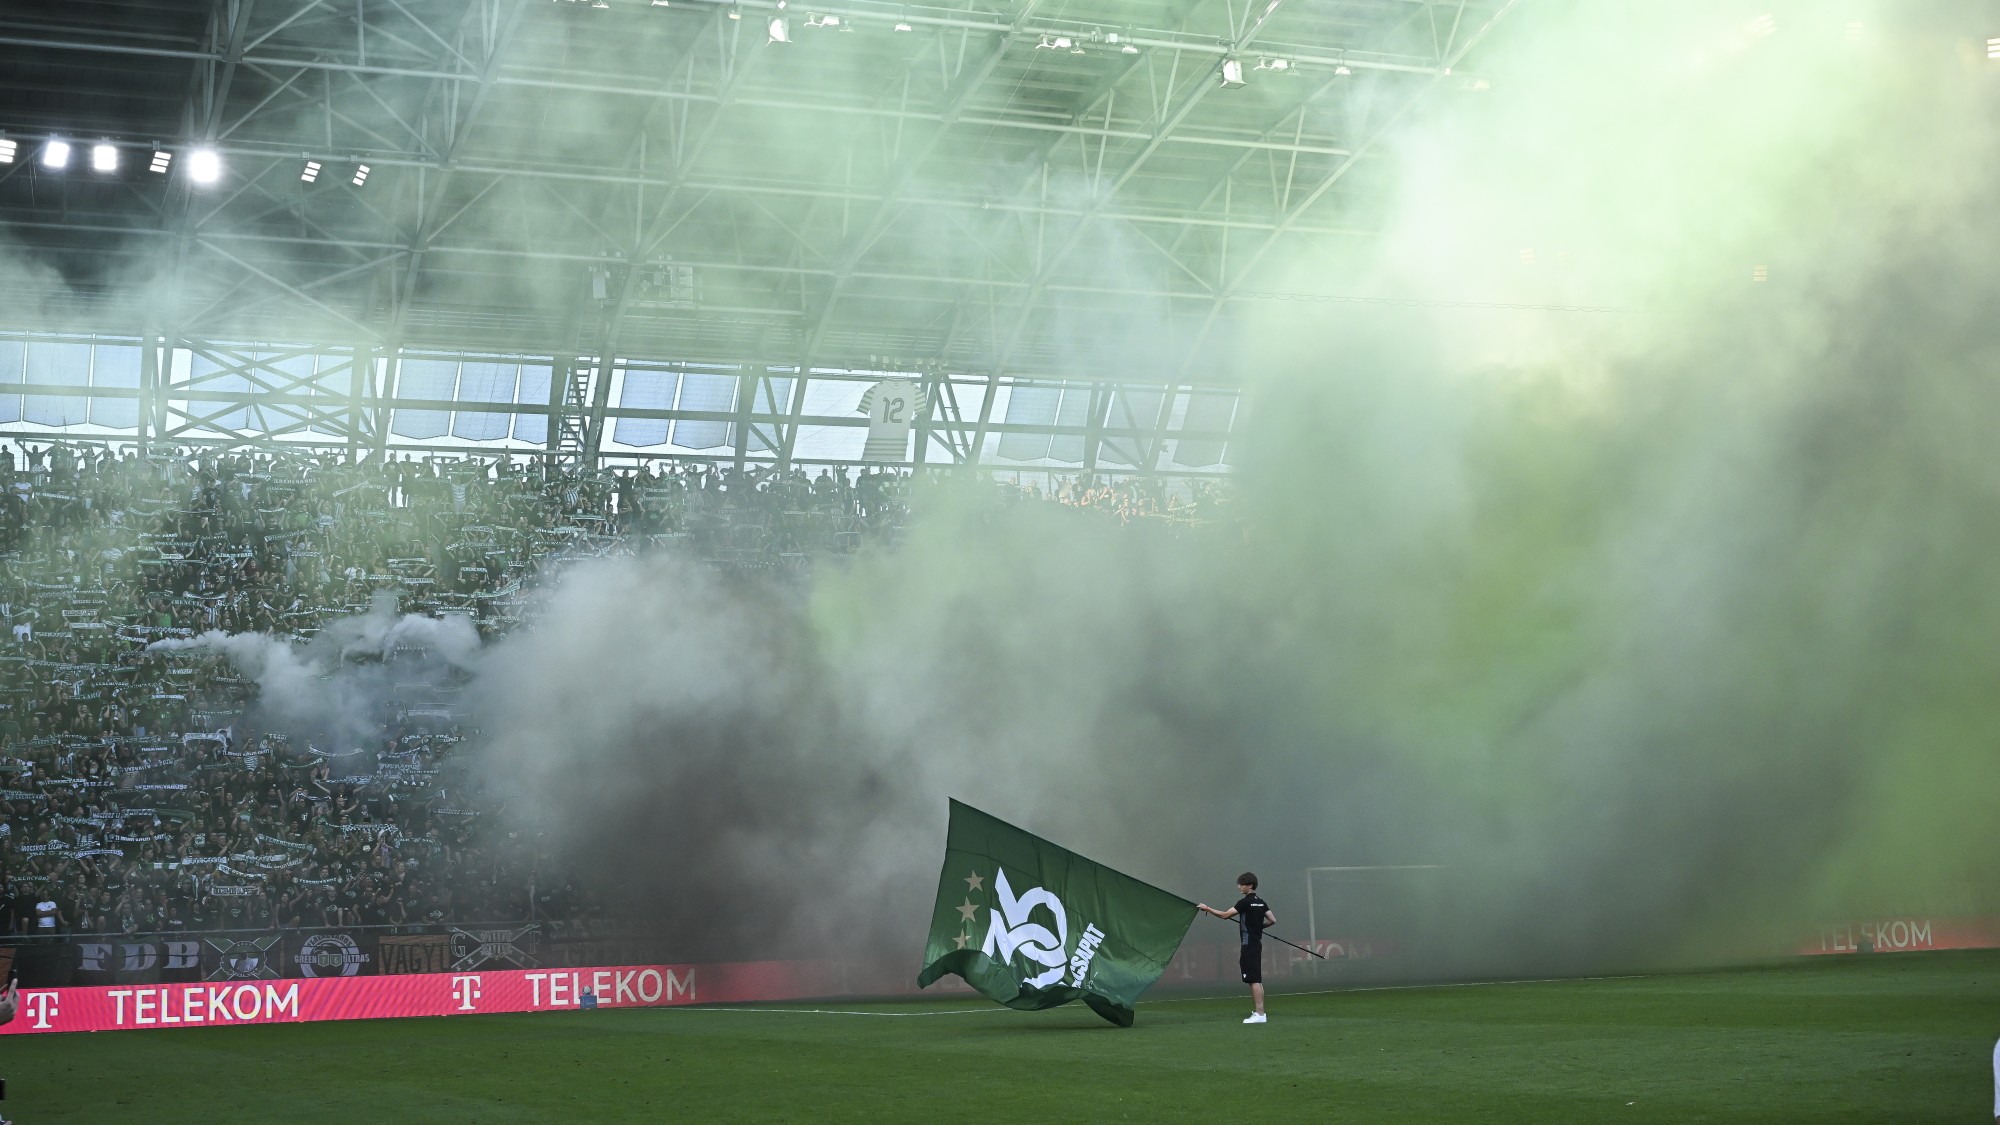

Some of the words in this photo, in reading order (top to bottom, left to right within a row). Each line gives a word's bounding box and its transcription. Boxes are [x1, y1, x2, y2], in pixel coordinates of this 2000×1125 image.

[883, 397, 905, 424] 12
[294, 954, 317, 963] GREEN
[342, 953, 370, 963] ULTRAS
[107, 984, 299, 1025] TELEKOM
[453, 976, 481, 1010] T
[525, 968, 696, 1007] TELEKOM
[27, 992, 59, 1029] T
